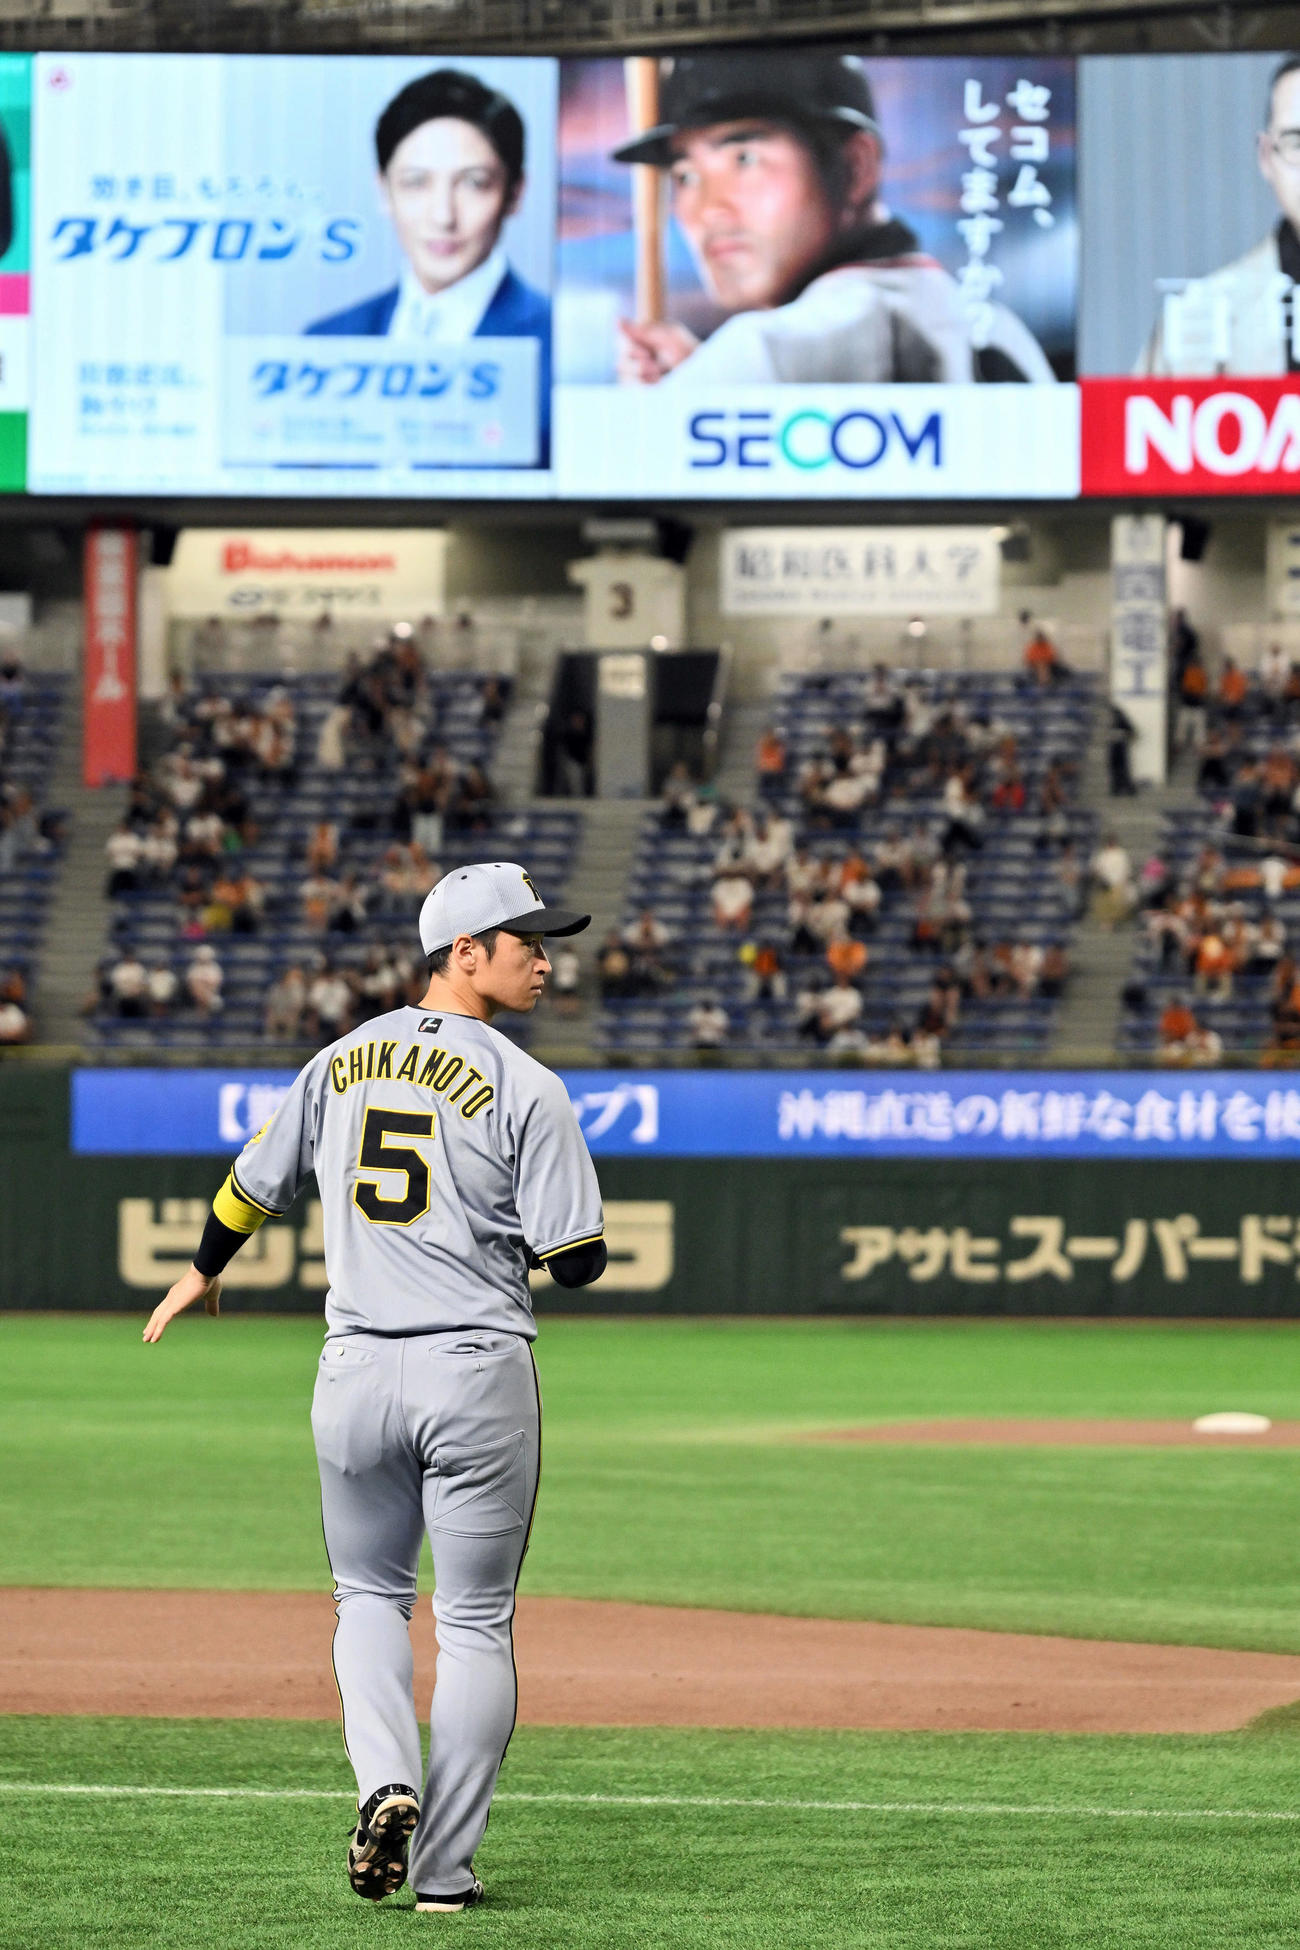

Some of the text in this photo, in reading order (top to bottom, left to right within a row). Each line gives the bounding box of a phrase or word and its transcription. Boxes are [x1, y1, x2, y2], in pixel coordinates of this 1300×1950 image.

[688, 410, 944, 470] SECOM
[609, 582, 634, 620] 3
[331, 1040, 494, 1120] CHIKAMOTO
[353, 1105, 436, 1226] 5
[840, 1213, 1300, 1284] アサヒスーパード
